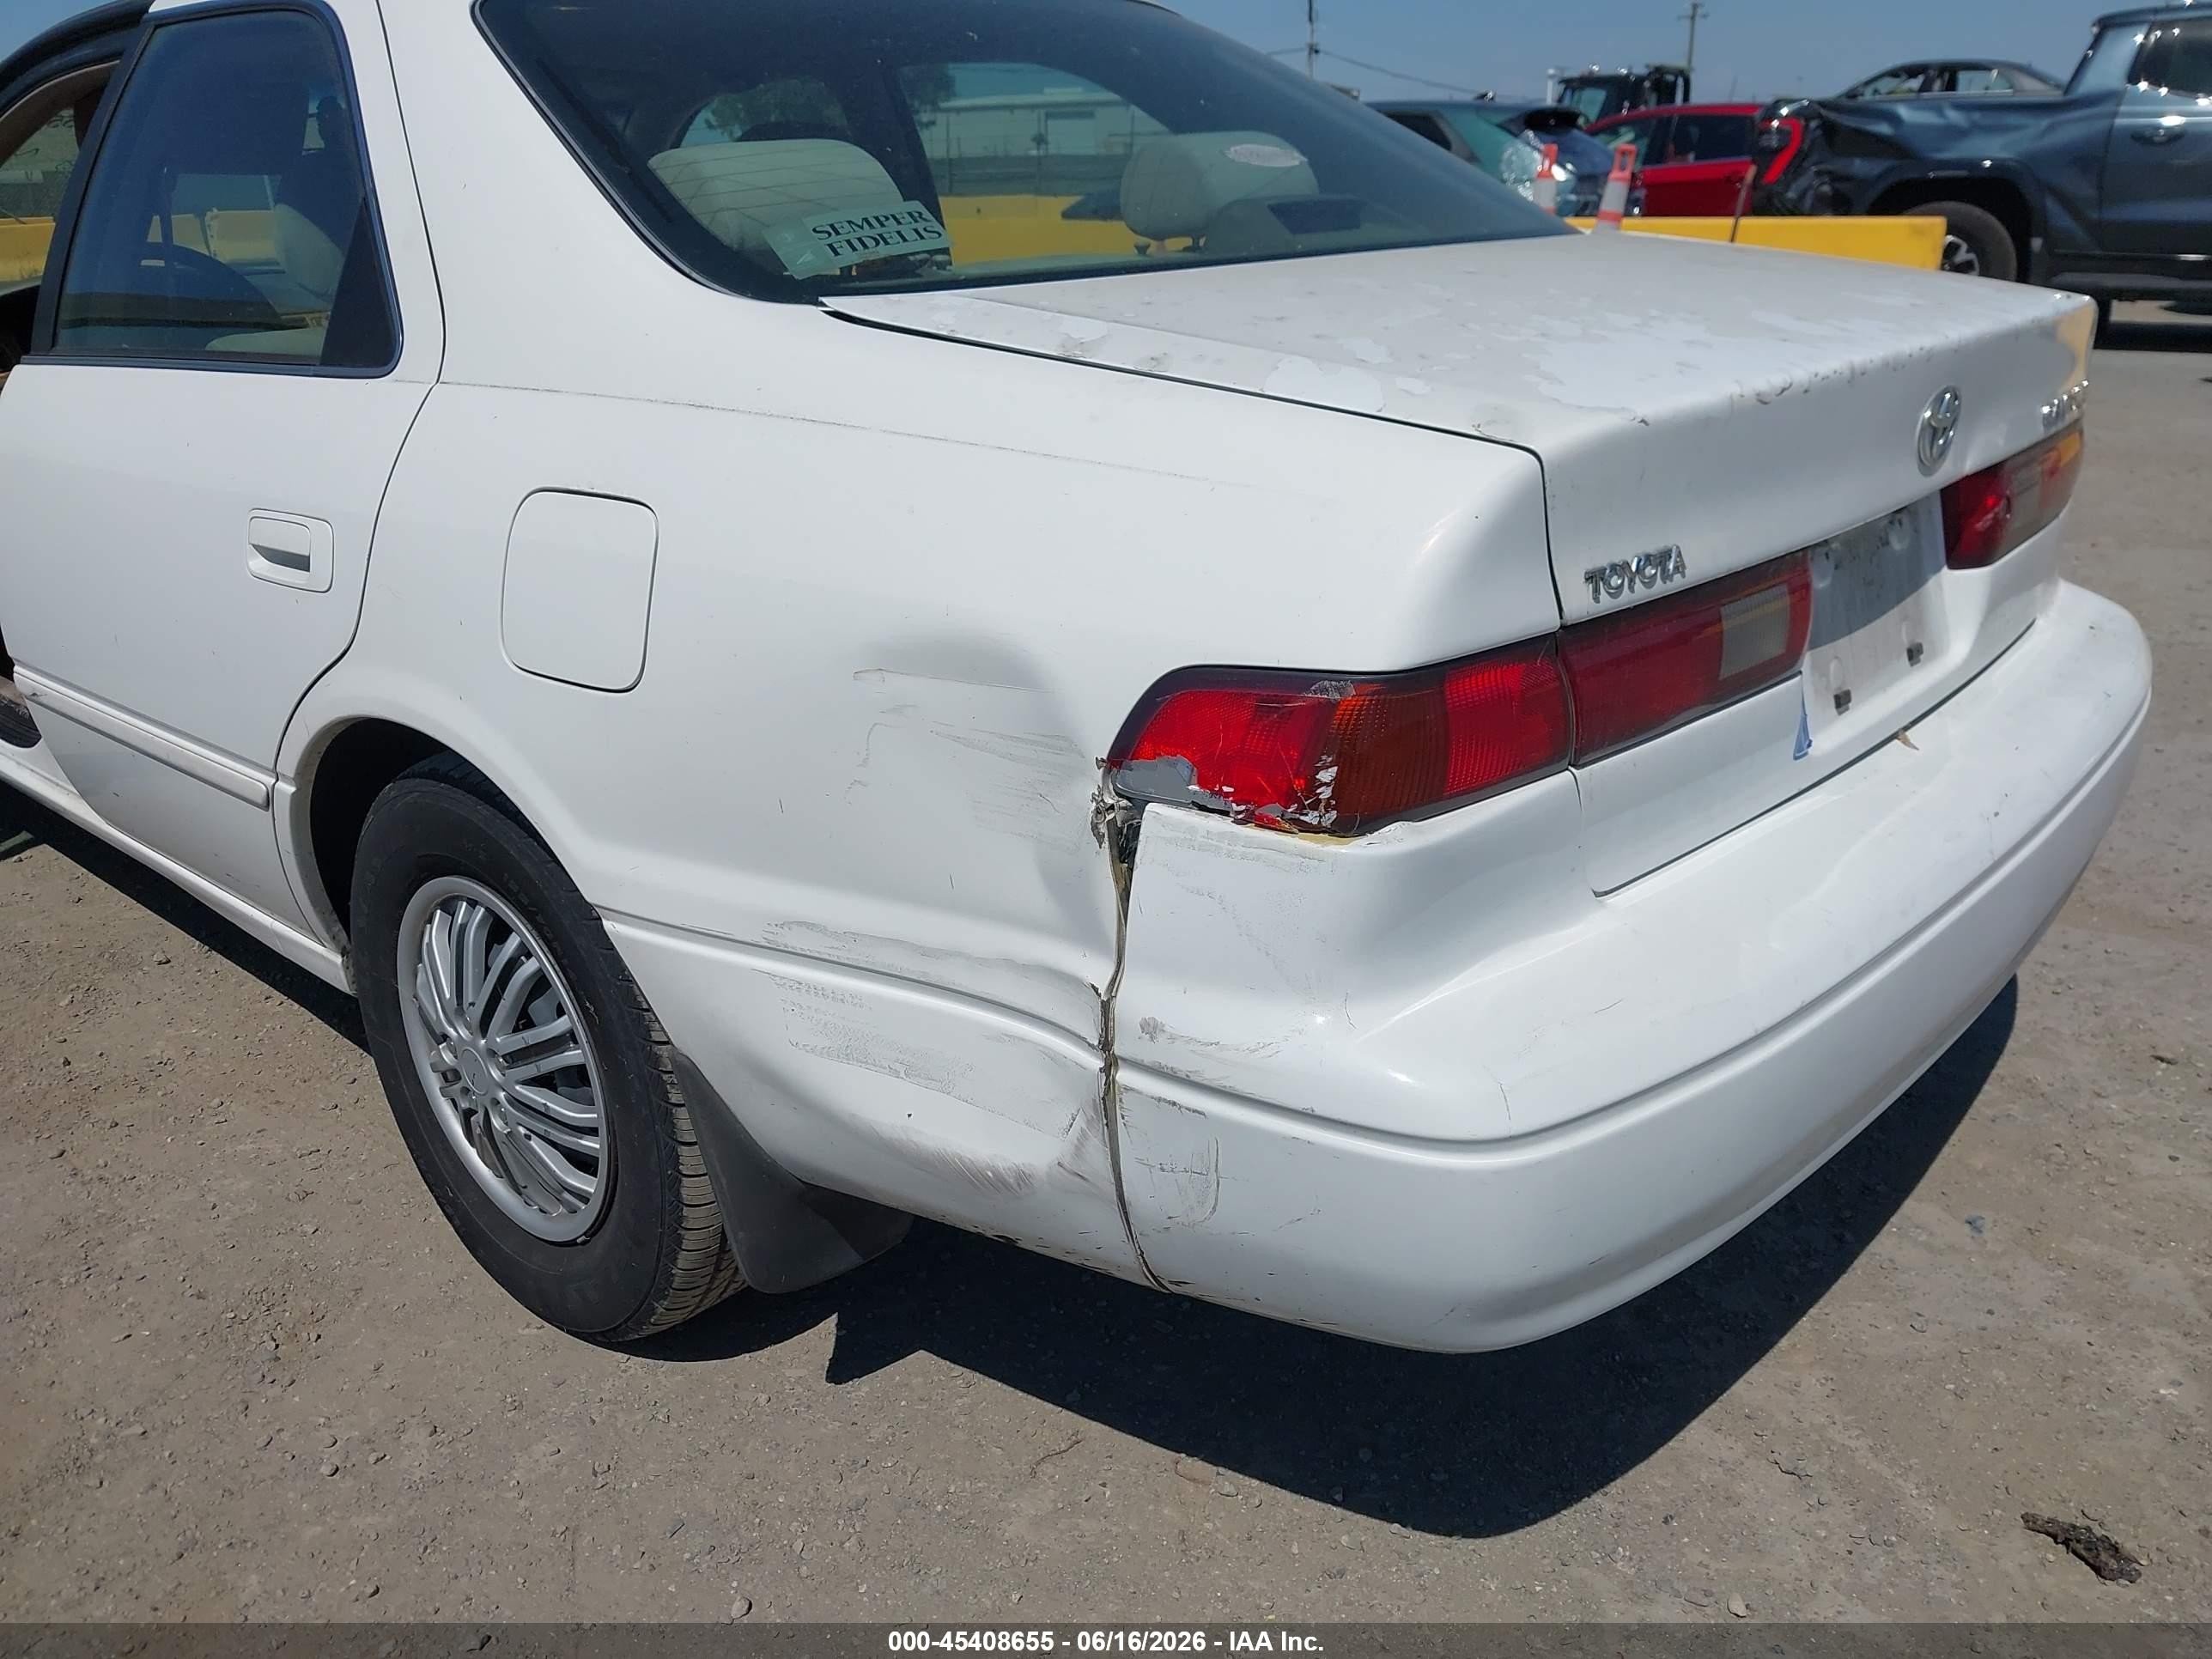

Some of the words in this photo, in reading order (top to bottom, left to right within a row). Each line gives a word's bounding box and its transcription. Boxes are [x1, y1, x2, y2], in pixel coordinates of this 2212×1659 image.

[811, 210, 932, 240] SEMPER
[824, 226, 942, 257] FIDELIS
[1584, 544, 1686, 604] TOYOTA
